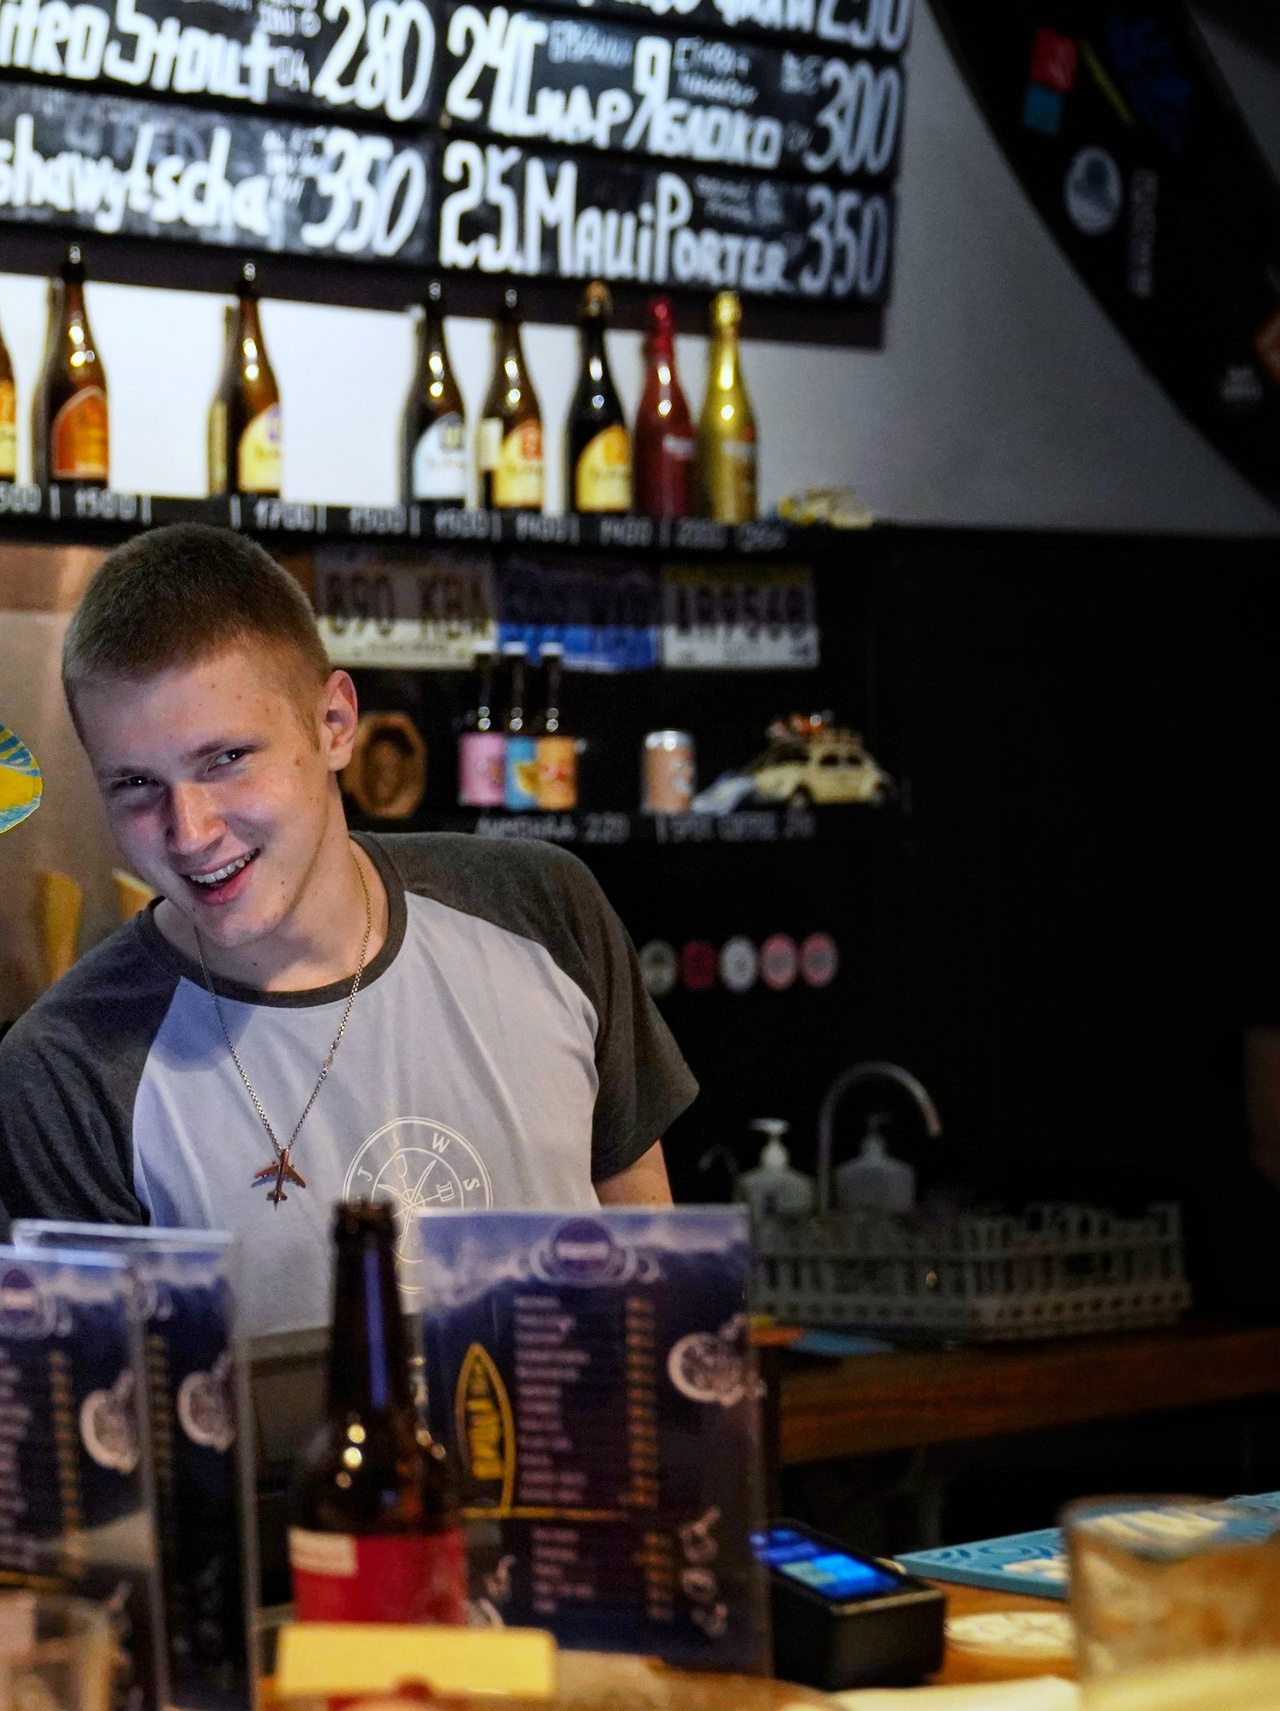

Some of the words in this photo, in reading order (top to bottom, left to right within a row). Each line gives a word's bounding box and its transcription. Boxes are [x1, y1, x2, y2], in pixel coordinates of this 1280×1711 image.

[803, 59, 902, 175] 300
[300, 125, 427, 258] 350
[799, 182, 890, 297] 350
